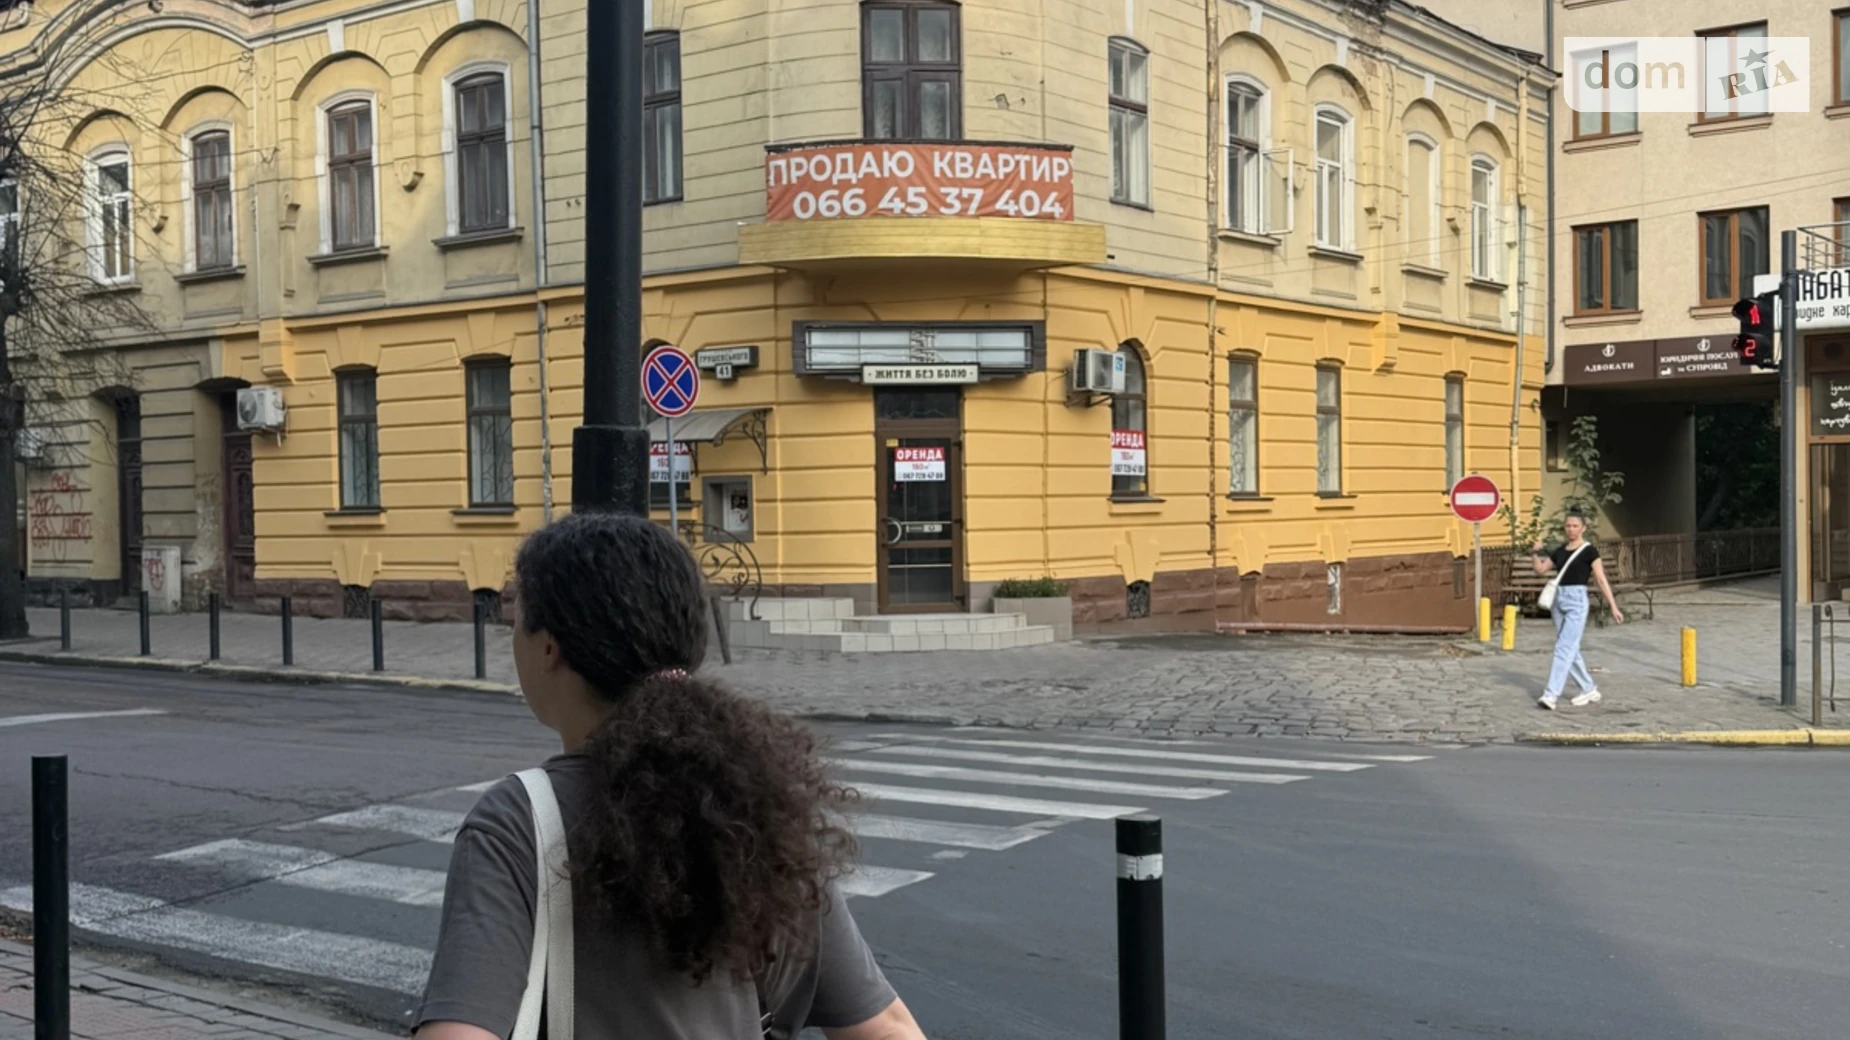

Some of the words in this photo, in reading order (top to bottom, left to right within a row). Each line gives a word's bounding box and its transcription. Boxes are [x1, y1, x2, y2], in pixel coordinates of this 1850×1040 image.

[768, 150, 915, 187] ПРОДАЮ
[932, 151, 1073, 184] КВАРТИР
[793, 189, 867, 220] 066
[877, 187, 929, 215] 45
[939, 187, 984, 215] 37
[995, 189, 1065, 219] 404
[719, 365, 730, 377] 41
[1584, 361, 1635, 373] АДВОКАТИ
[875, 369, 912, 379] ЖИТТЯ
[915, 369, 935, 379] БЕЗ
[937, 368, 968, 379] БОЛЮ
[896, 448, 944, 461] ОРЕНДА
